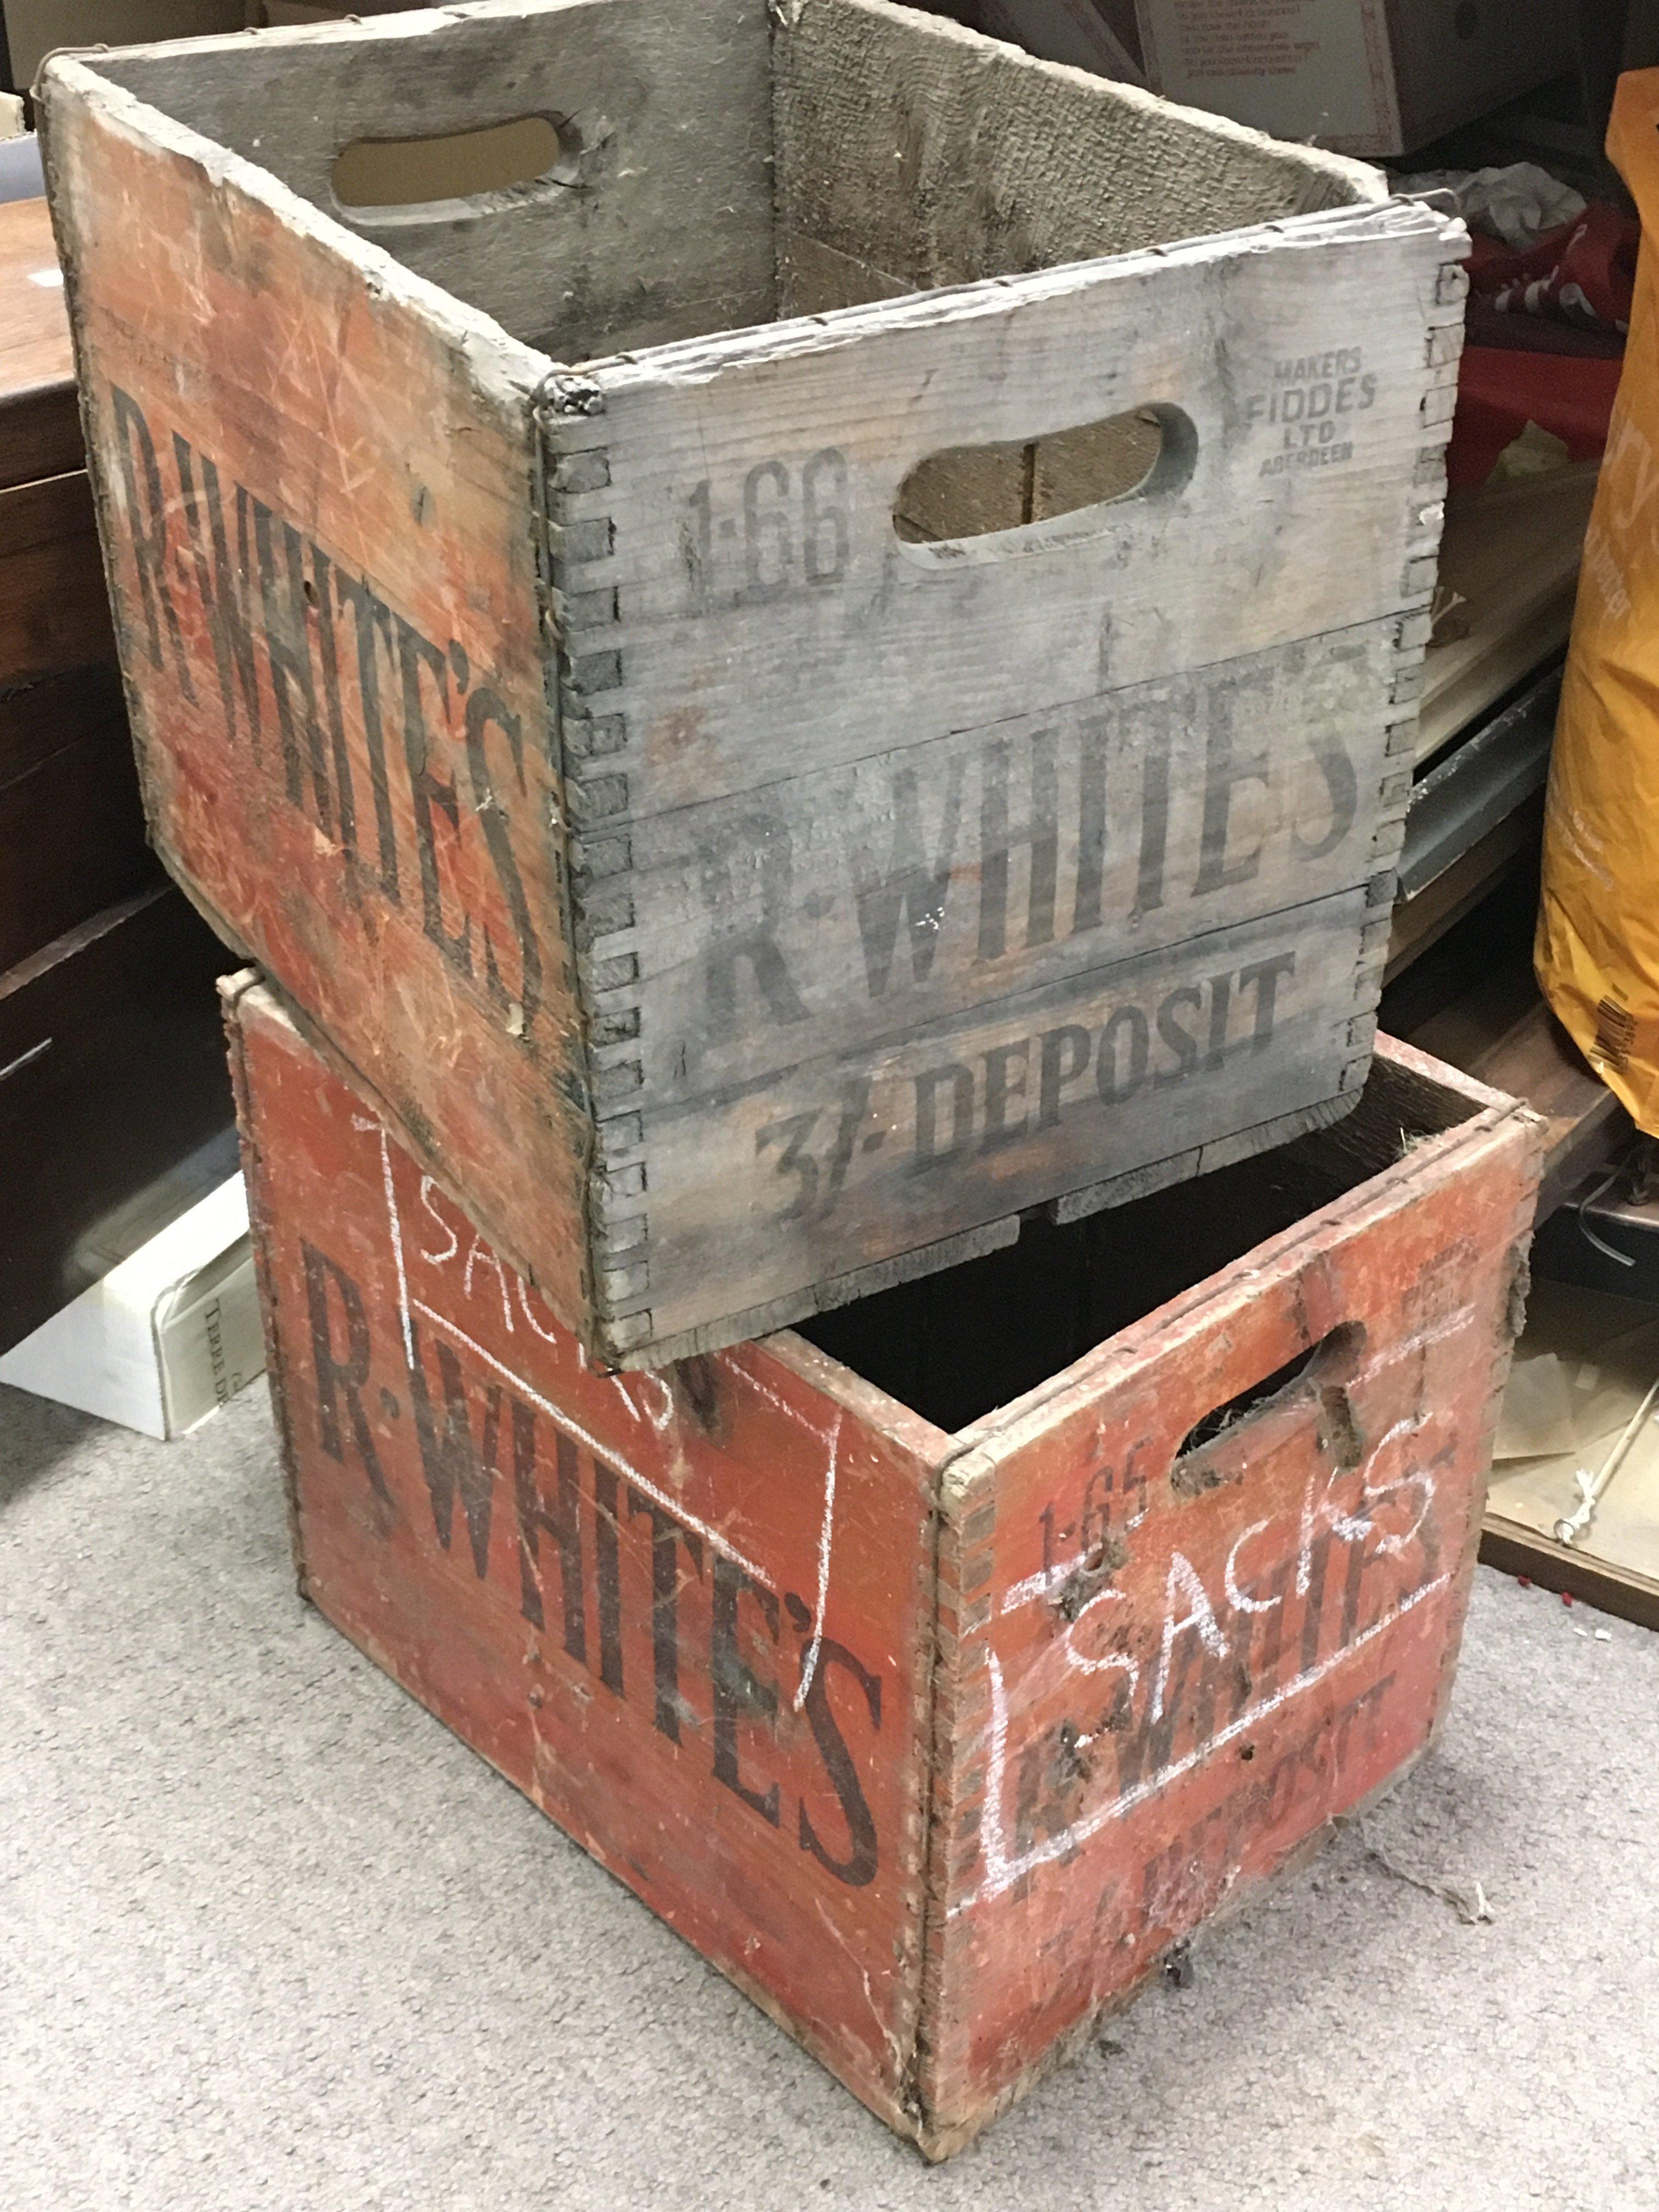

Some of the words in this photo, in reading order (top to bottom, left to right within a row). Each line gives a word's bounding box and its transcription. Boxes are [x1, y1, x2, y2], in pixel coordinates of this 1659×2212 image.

[1273, 345, 1362, 380] MAKERS
[1244, 373, 1377, 426] FIDDES
[1283, 420, 1334, 450] LTD
[913, 951, 1297, 1178] DEPOSIT
[1065, 1411, 1437, 1749] SACKS
